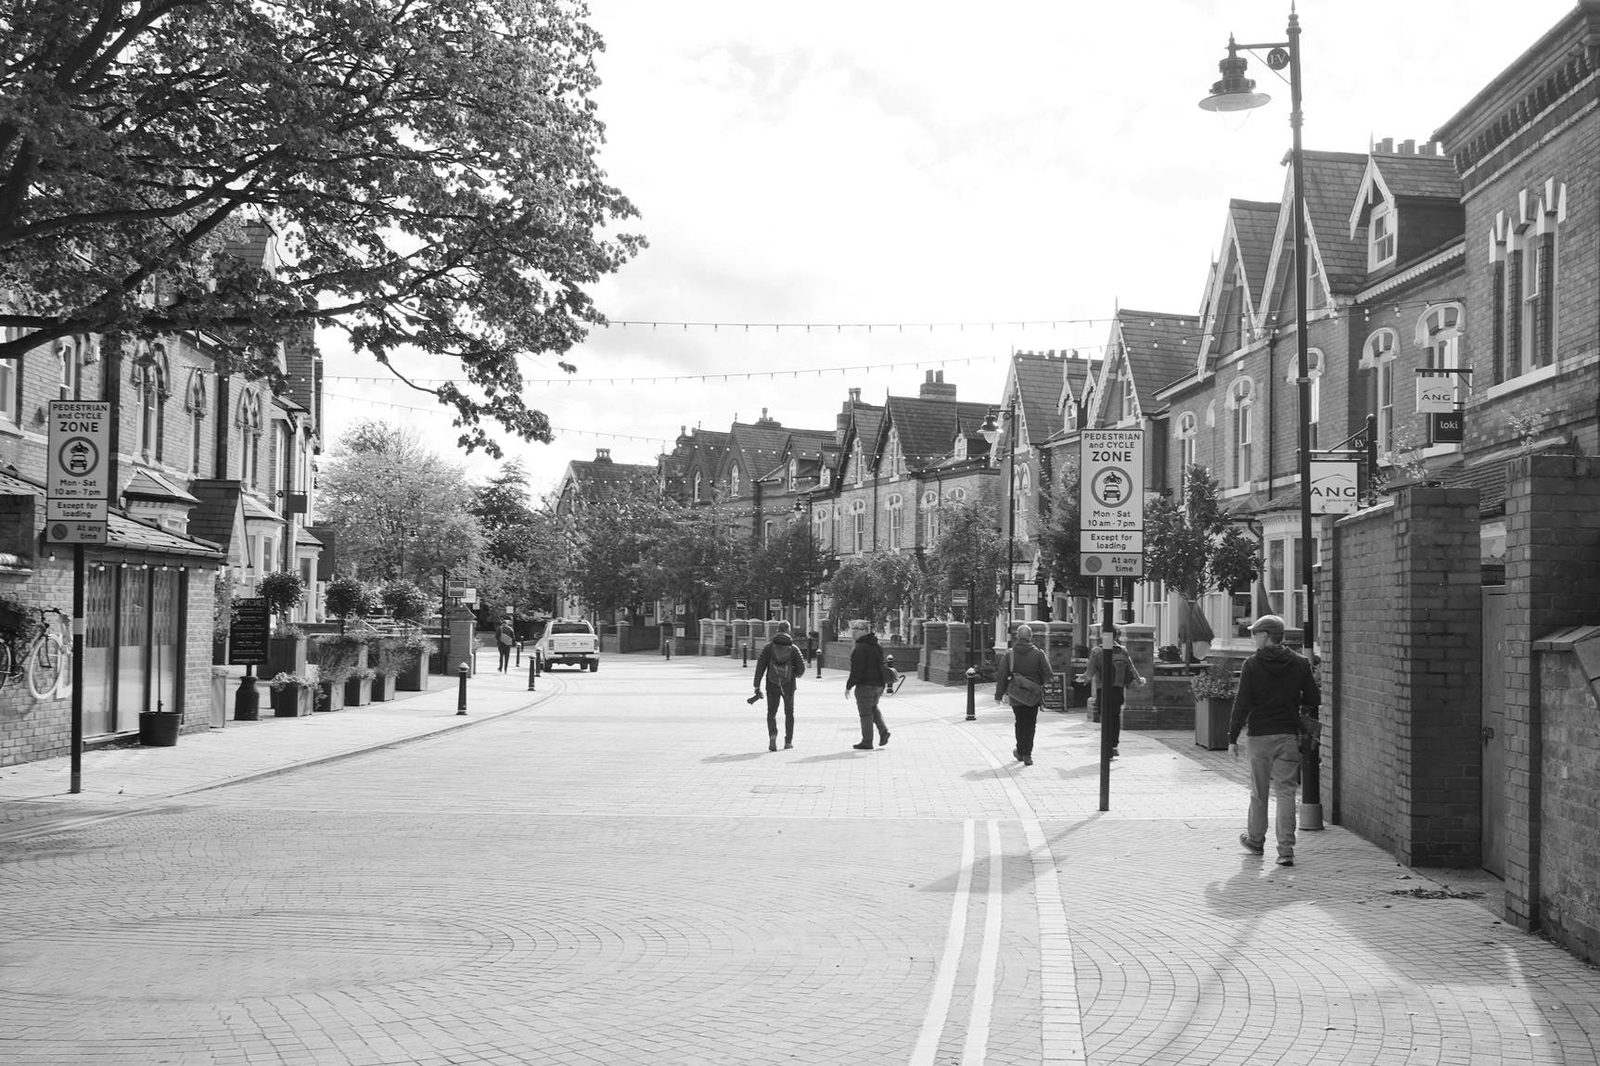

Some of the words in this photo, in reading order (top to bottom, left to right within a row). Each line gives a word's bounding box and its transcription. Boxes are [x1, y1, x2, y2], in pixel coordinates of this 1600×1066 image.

[60, 422, 98, 432] ZONE
[1440, 421, 1459, 429] loki
[1092, 451, 1132, 462] ZONE
[1310, 487, 1356, 497] ANG
